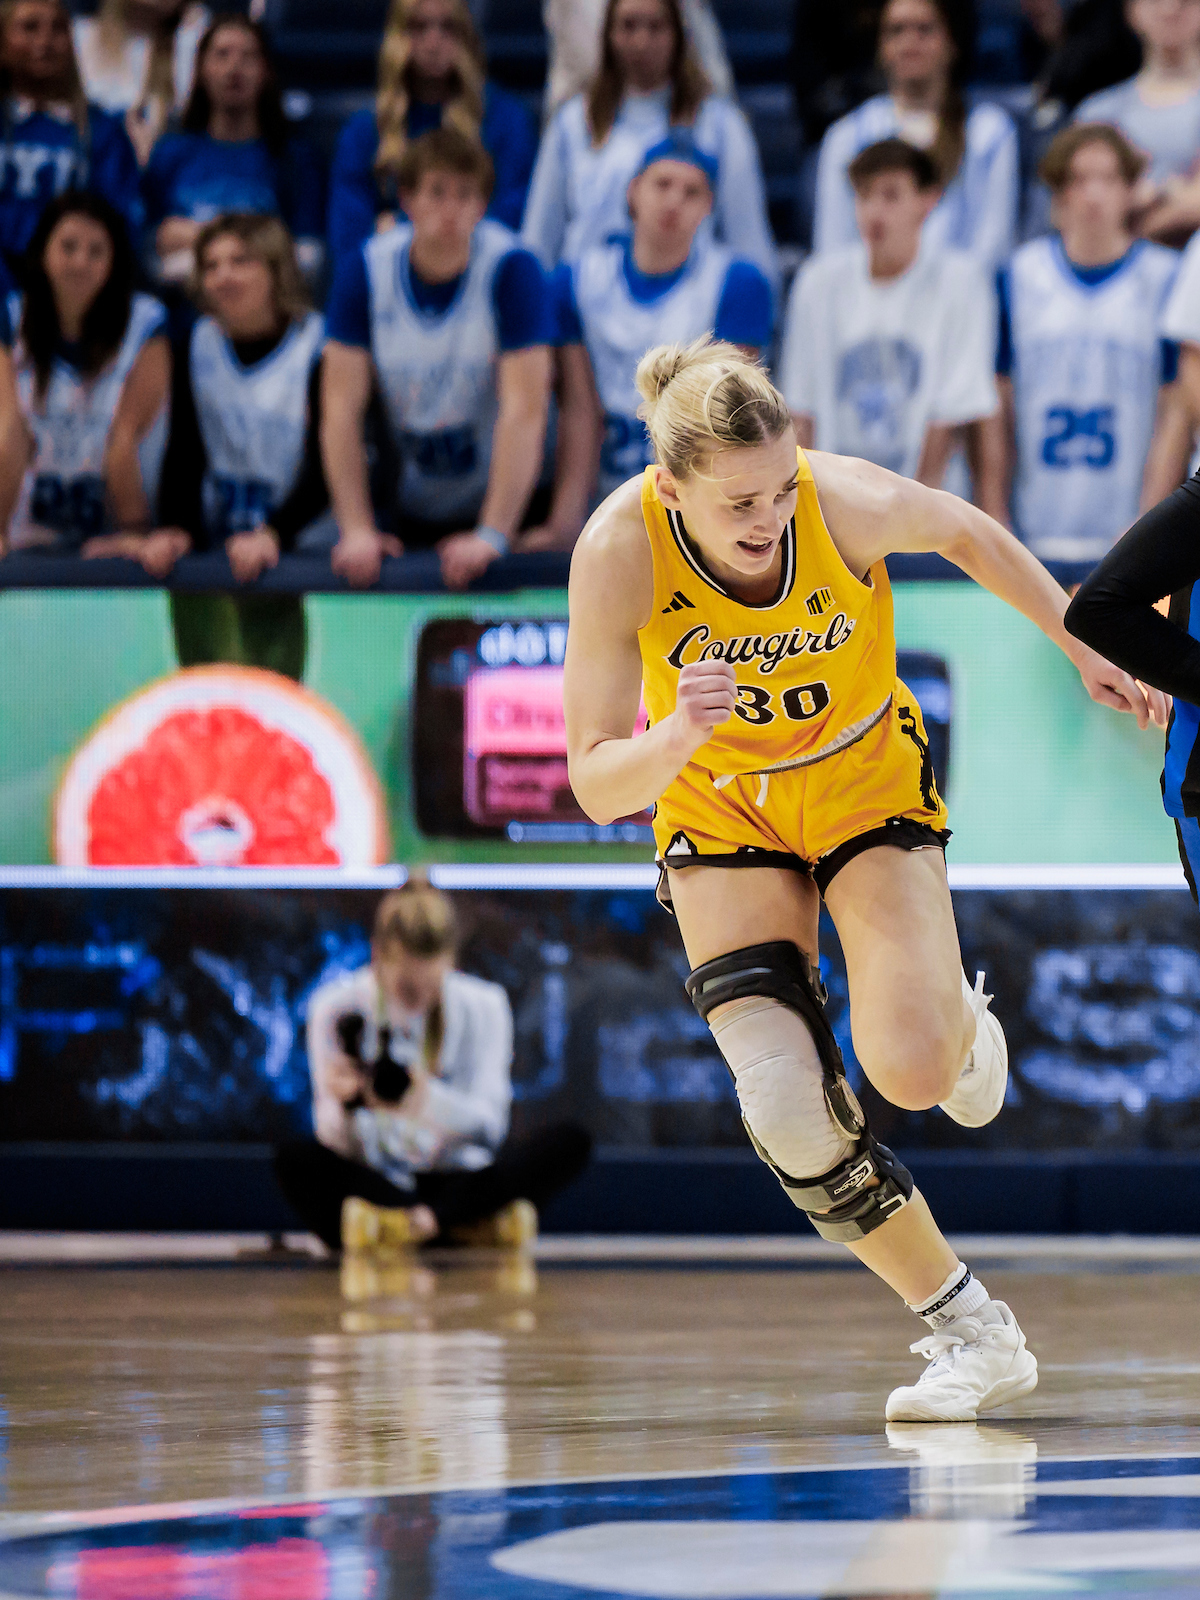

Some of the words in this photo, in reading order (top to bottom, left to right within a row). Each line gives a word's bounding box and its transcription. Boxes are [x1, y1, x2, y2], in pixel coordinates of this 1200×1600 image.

[1041, 404, 1118, 469] 25
[662, 612, 857, 675] Cowgirls
[735, 679, 832, 727] 30
